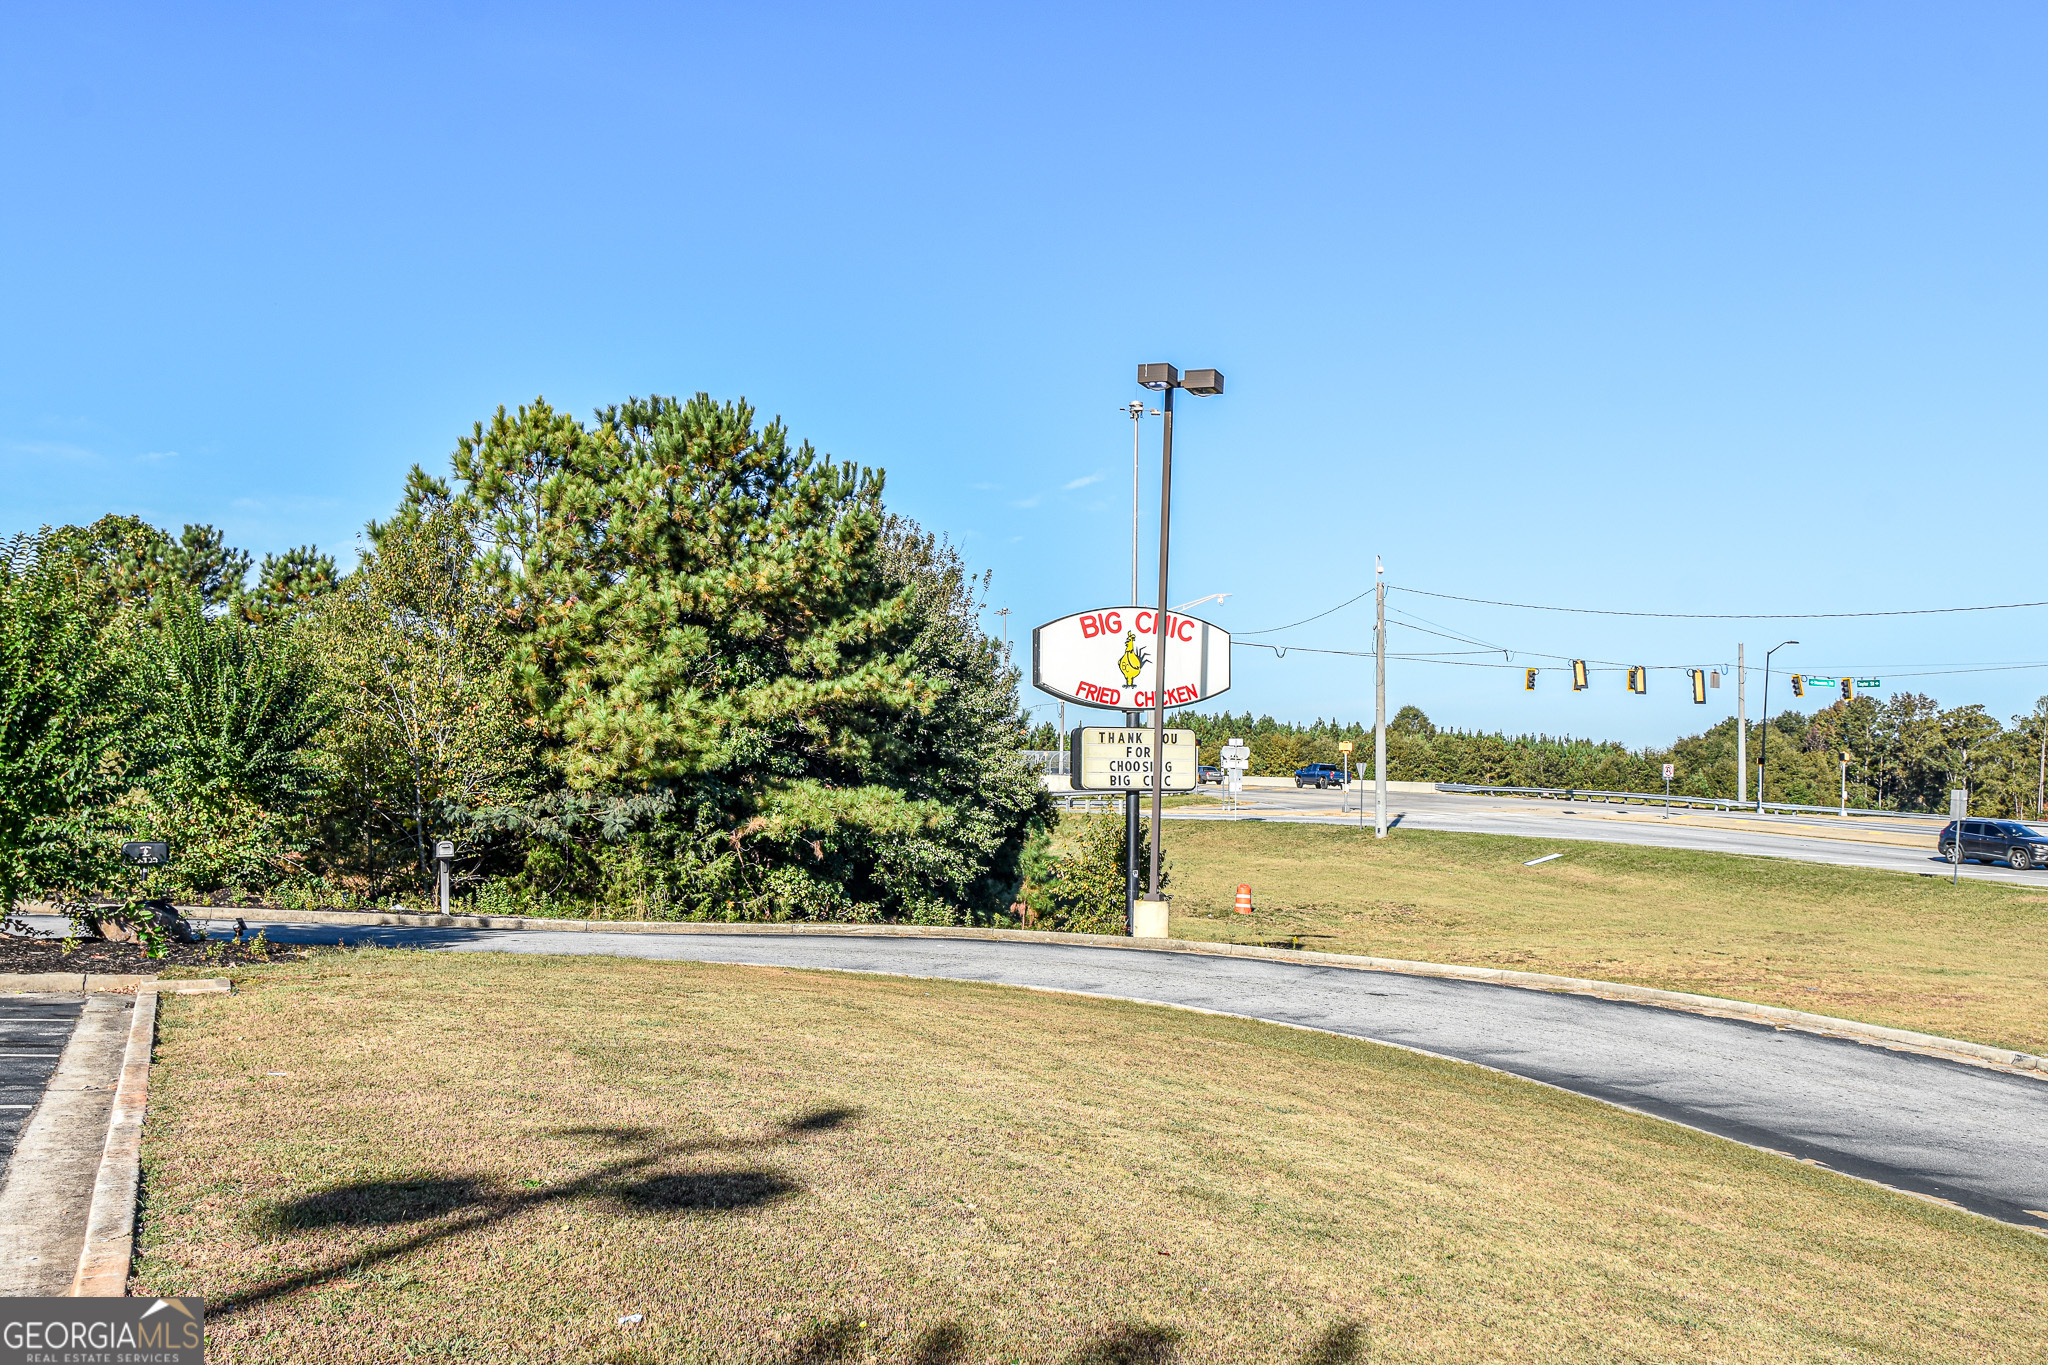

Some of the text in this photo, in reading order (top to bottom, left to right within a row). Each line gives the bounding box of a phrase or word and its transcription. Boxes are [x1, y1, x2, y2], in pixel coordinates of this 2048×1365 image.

[1080, 612, 1122, 638] BIG
[1075, 681, 1120, 705] FRIED
[1099, 732, 1178, 744] THANK OU
[1126, 746, 1151, 758] FOR
[1109, 760, 1172, 772] CHOOSIG
[1110, 775, 1171, 787] BIG CC
